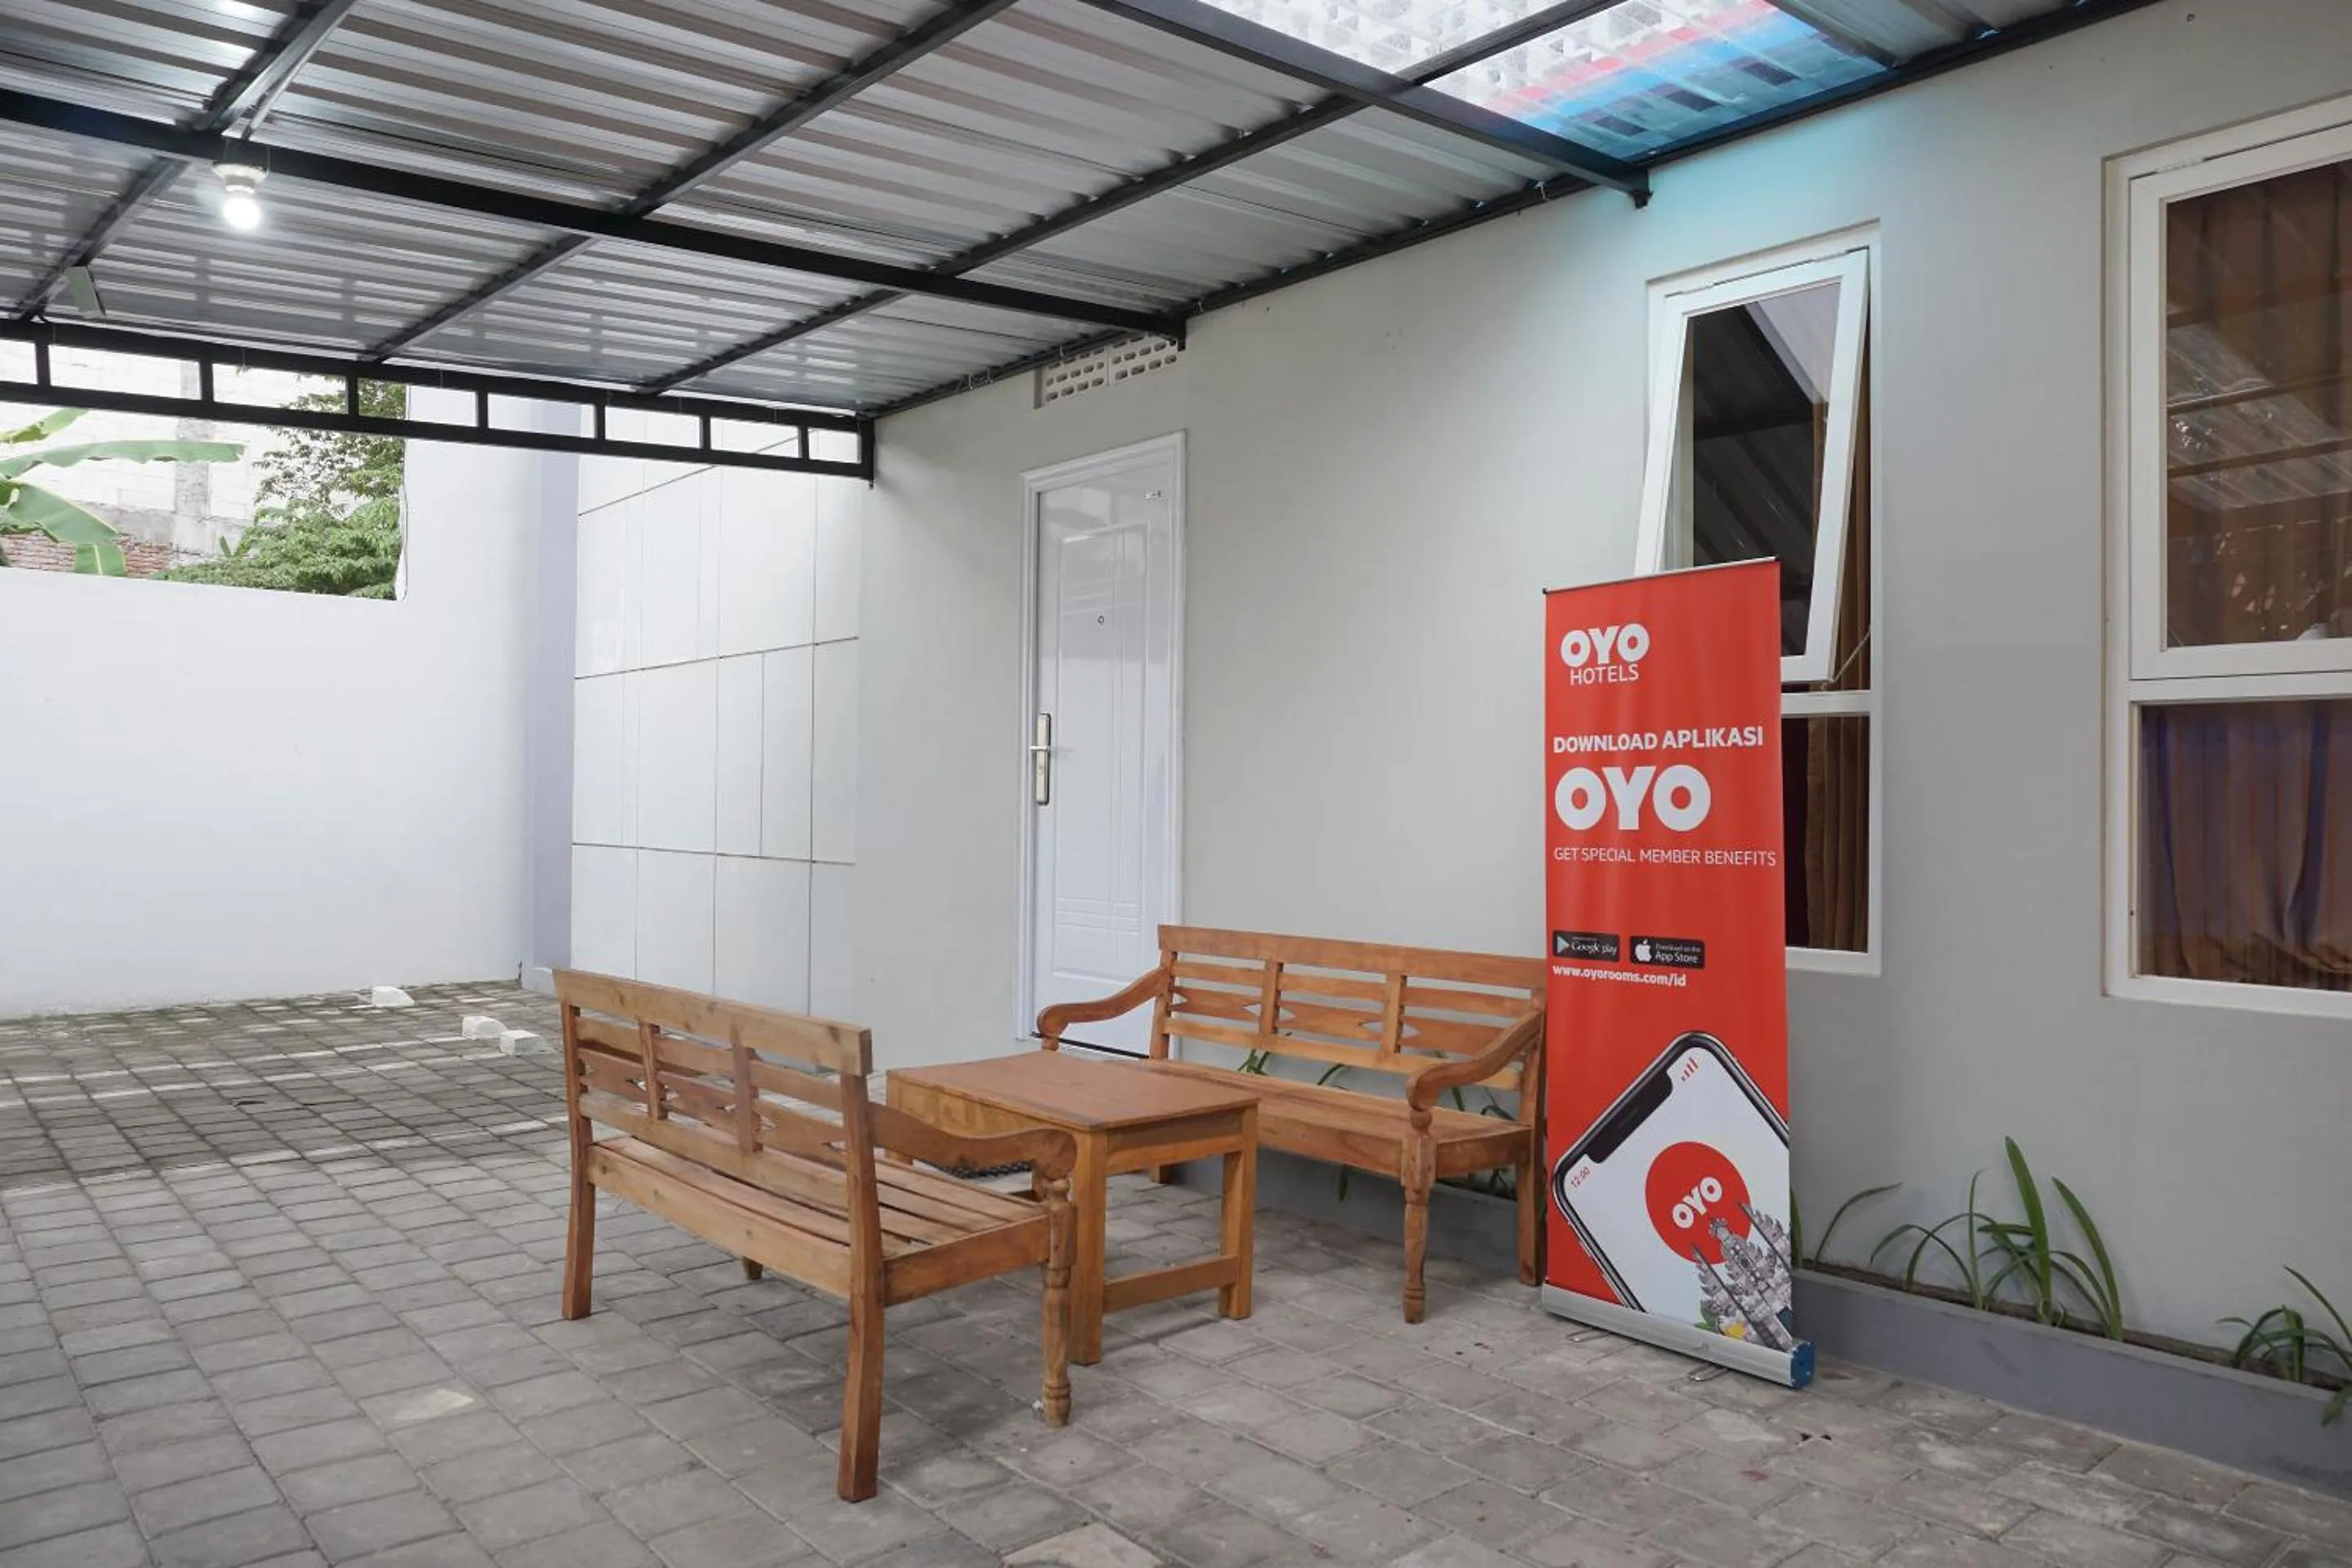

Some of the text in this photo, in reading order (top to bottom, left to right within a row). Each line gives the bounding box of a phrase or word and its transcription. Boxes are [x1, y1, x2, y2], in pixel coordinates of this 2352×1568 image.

[1561, 623, 1650, 667] OYO
[1570, 664, 1639, 685] HOTELS
[1553, 726, 1763, 753] DOWNLOAD APLIKASI
[1554, 764, 1712, 831] OYO
[1554, 848, 1776, 866] GET SPECIAL MEMBER BENEFITS
[1655, 951, 1698, 964] App Store
[1552, 965, 1686, 987] www.oyorooms.com/id
[1672, 1176, 1722, 1228] OYO
